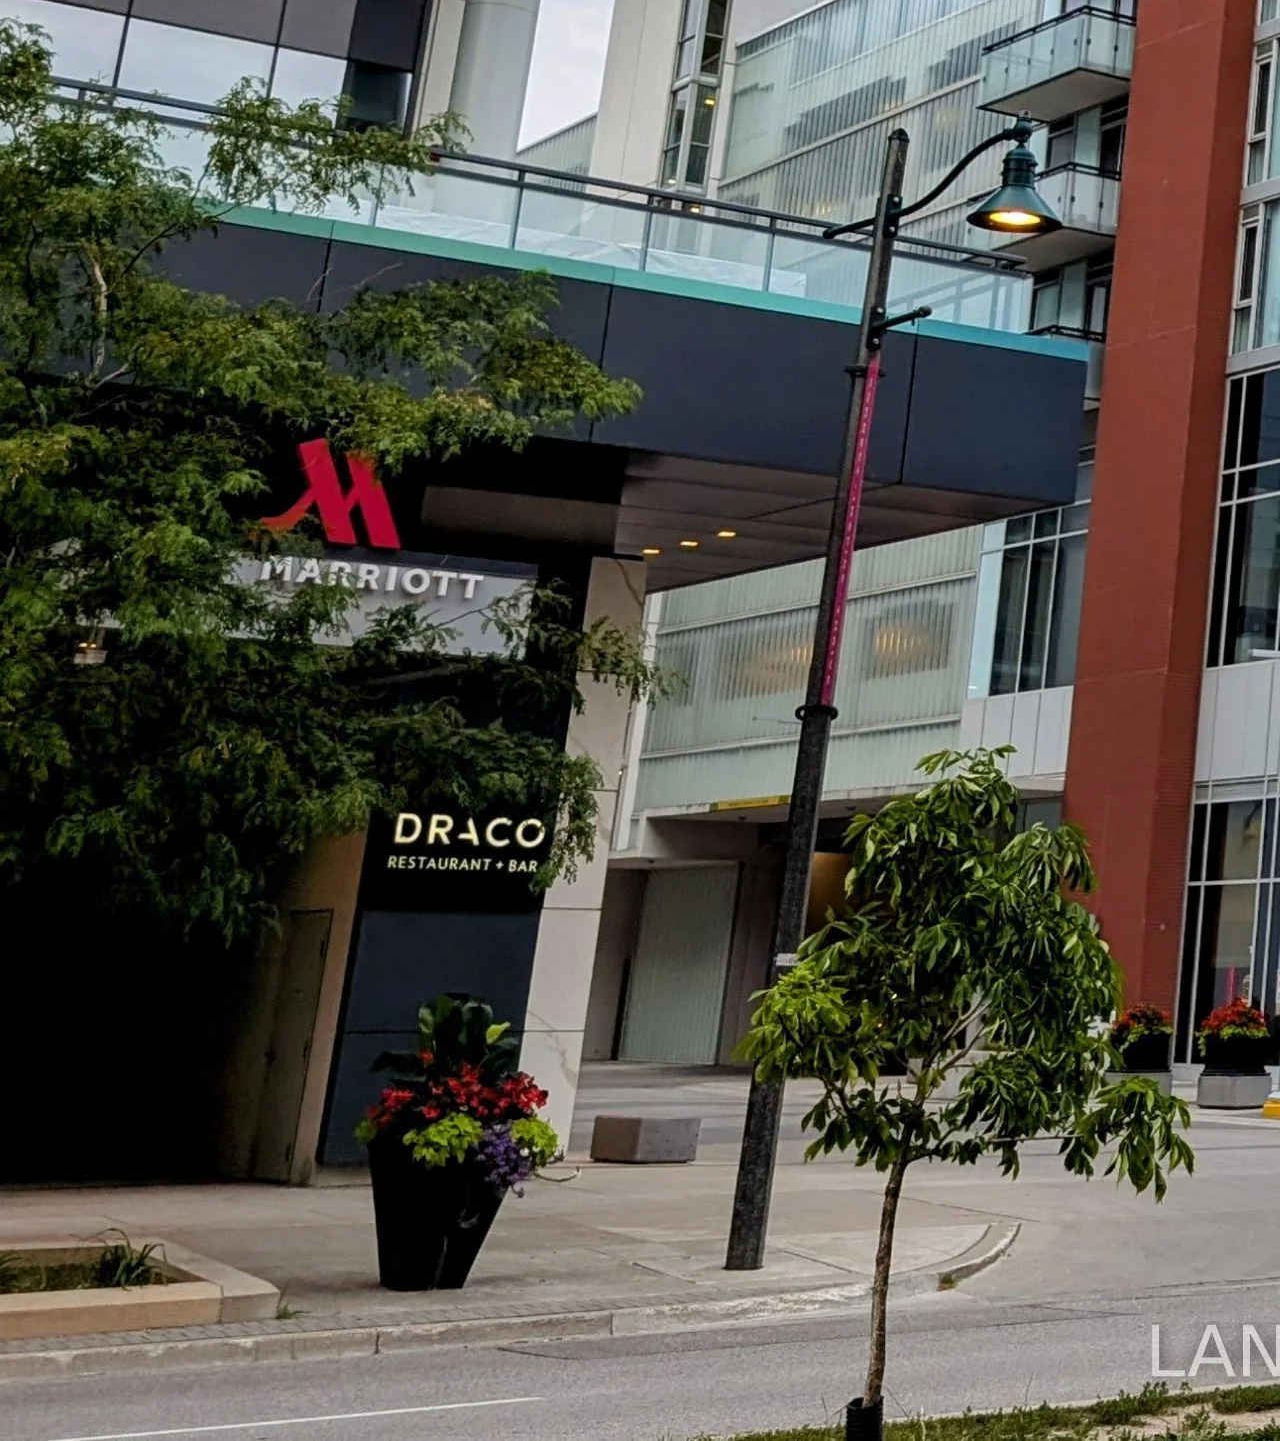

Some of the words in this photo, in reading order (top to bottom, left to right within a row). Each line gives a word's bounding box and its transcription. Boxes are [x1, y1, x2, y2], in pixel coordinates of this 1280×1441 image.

[260, 555, 484, 599] MARRIOTT
[393, 812, 547, 848] DRACO
[387, 855, 492, 871] RESTAURANT
[508, 859, 538, 873] BAR
